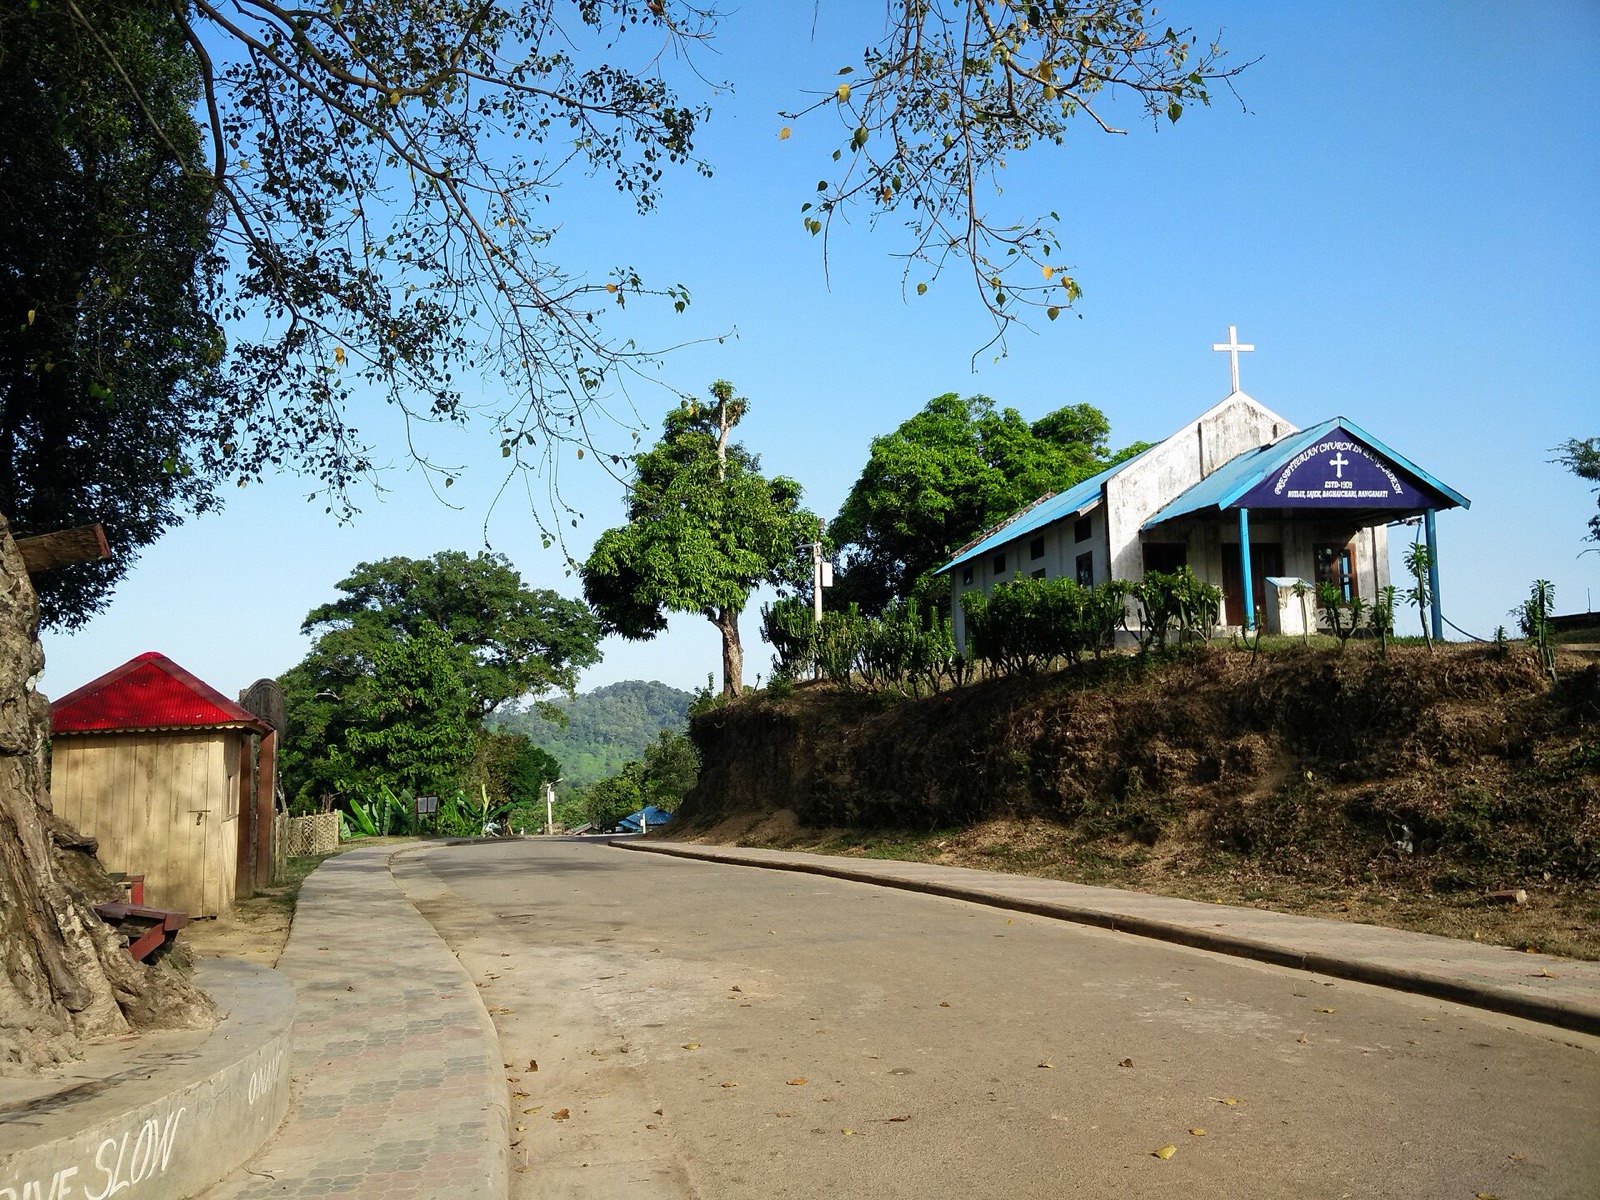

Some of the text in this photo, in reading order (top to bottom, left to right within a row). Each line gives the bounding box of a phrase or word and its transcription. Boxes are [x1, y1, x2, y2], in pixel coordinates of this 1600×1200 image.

[1274, 441, 1404, 495] PRESBYTERIAN CHURCH IN BANGLADESH
[84, 1106, 187, 1200] SLOW
